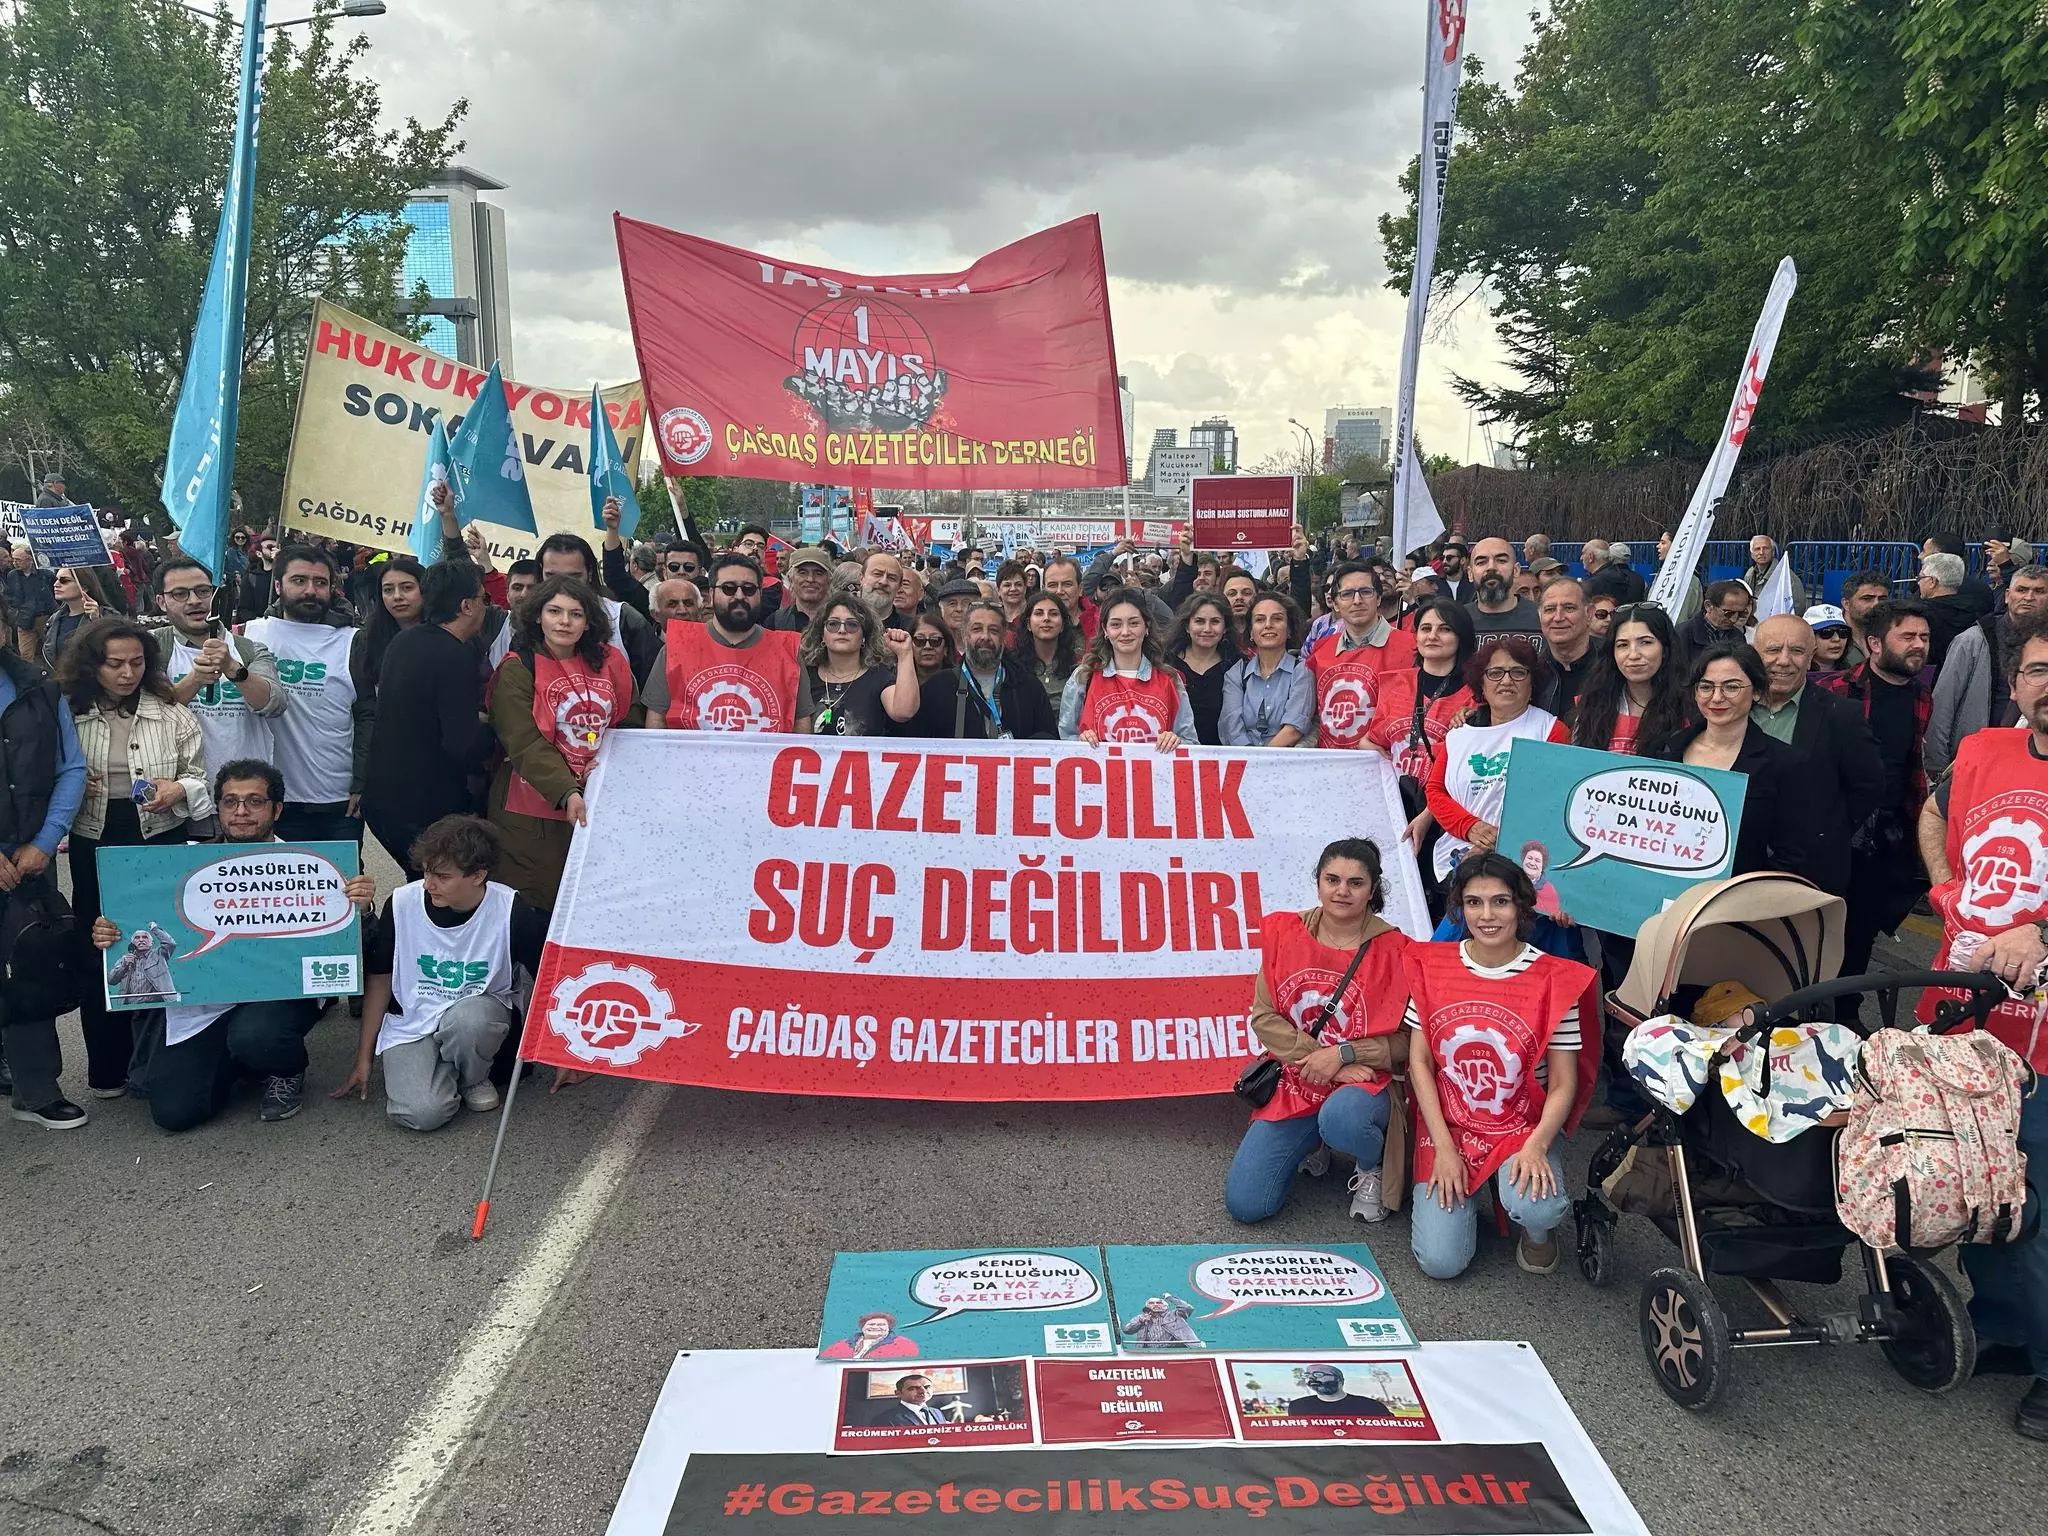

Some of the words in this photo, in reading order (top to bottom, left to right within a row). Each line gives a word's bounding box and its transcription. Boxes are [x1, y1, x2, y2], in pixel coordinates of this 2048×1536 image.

[853, 304, 870, 346] 1
[803, 346, 924, 386] MAYIS
[315, 320, 489, 401] HUKUK
[501, 379, 642, 431] YOKSA
[725, 423, 818, 469] ÇAĞDAŞ
[825, 430, 987, 466] GAZETECİLER
[992, 425, 1096, 466] DERNEĞİ
[297, 496, 387, 531] ÇAĞDAŞ
[1196, 508, 1216, 519] ÖZGÜR
[1217, 509, 1236, 519] BASIN
[941, 523, 954, 531] 63
[1050, 524, 1075, 533] KADAR
[1076, 524, 1110, 533] TOPLAM
[1467, 752, 1511, 777] tg
[766, 744, 1256, 841] GAZETECİLİK
[1627, 776, 1679, 797] KENDİ
[1585, 787, 1719, 824] YOKSULLUĞUNU
[1616, 813, 1638, 828] DA
[1644, 818, 1677, 836] YAZ
[1585, 826, 1668, 854] GAZETECİ
[1672, 842, 1705, 862] YAZ
[217, 862, 320, 877] SANSÜRLEN
[199, 878, 338, 894] OTOSANSÜRLEN
[213, 893, 326, 910] GAZETECİLİK
[747, 857, 897, 964] SUÇ
[921, 853, 1262, 955] DEĞİLDİR!
[311, 960, 350, 981] tgs
[416, 953, 489, 990] tgs
[1449, 1004, 1523, 1033] GAZETECİLER
[725, 1002, 878, 1068] ÇAĞDAŞ
[889, 1010, 1120, 1066] GAZETECİLER
[978, 1257, 1033, 1268] KENDİ
[1227, 1256, 1334, 1266] SANSÜRLEN
[931, 1267, 1081, 1279] YOKSULLUĞUNU
[1210, 1266, 1359, 1276] OTOSANSÜRLEN
[973, 1281, 998, 1291] DA
[1005, 1280, 1040, 1290] YAZ
[1227, 1276, 1349, 1287] GAZETECİLİK
[938, 1291, 1034, 1303] GAZETECİ
[1040, 1290, 1076, 1300] YAZ
[1054, 1326, 1102, 1342] tgs
[1349, 1321, 1398, 1337] tgs
[1087, 1366, 1168, 1382] GAZETECİLİK
[1116, 1384, 1143, 1400] SUÇ
[1101, 1397, 1164, 1415] DEĞİLDİR!
[840, 1427, 902, 1439] ERCÜMENT
[903, 1425, 963, 1438] AKDENİZ'E
[964, 1421, 1029, 1434] ÖZGÜRLÜK!
[1250, 1417, 1270, 1428] ALİ
[1273, 1418, 1309, 1428] BARIŞ
[1311, 1418, 1354, 1427] KURT'A
[1356, 1416, 1425, 1429] ÖZGÜRLÜK!
[724, 1473, 1532, 1519] #GazetecilikSuçDeğildir
